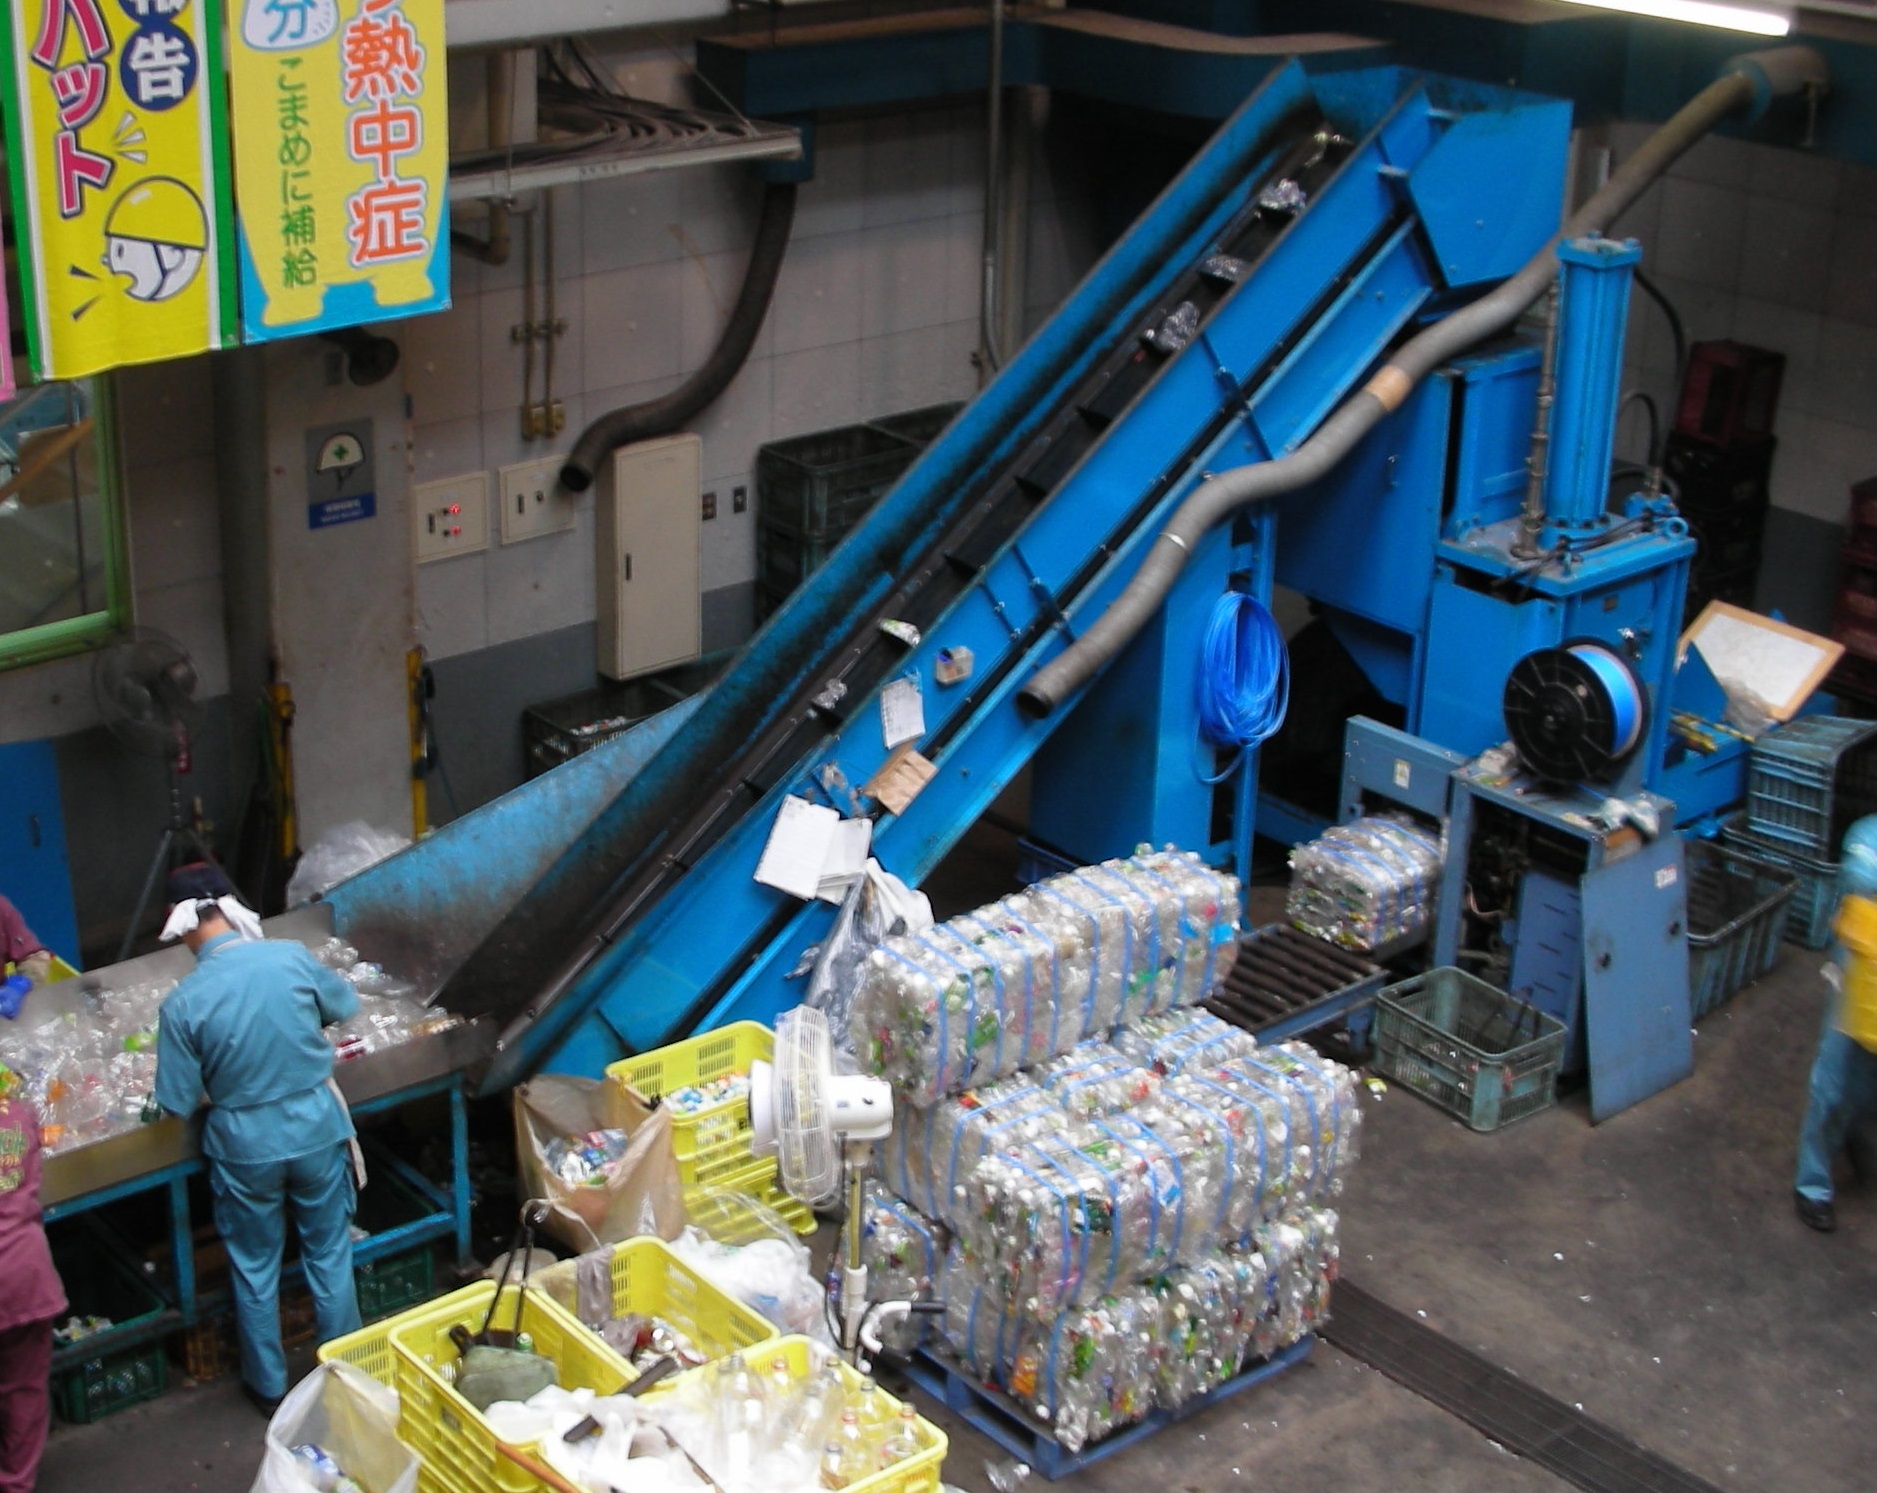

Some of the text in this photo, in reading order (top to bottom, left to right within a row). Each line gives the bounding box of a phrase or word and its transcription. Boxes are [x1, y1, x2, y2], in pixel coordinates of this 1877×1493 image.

[128, 0, 190, 103] 告
[345, 0, 426, 263] 熱中症
[278, 58, 317, 288] こまめに補給
